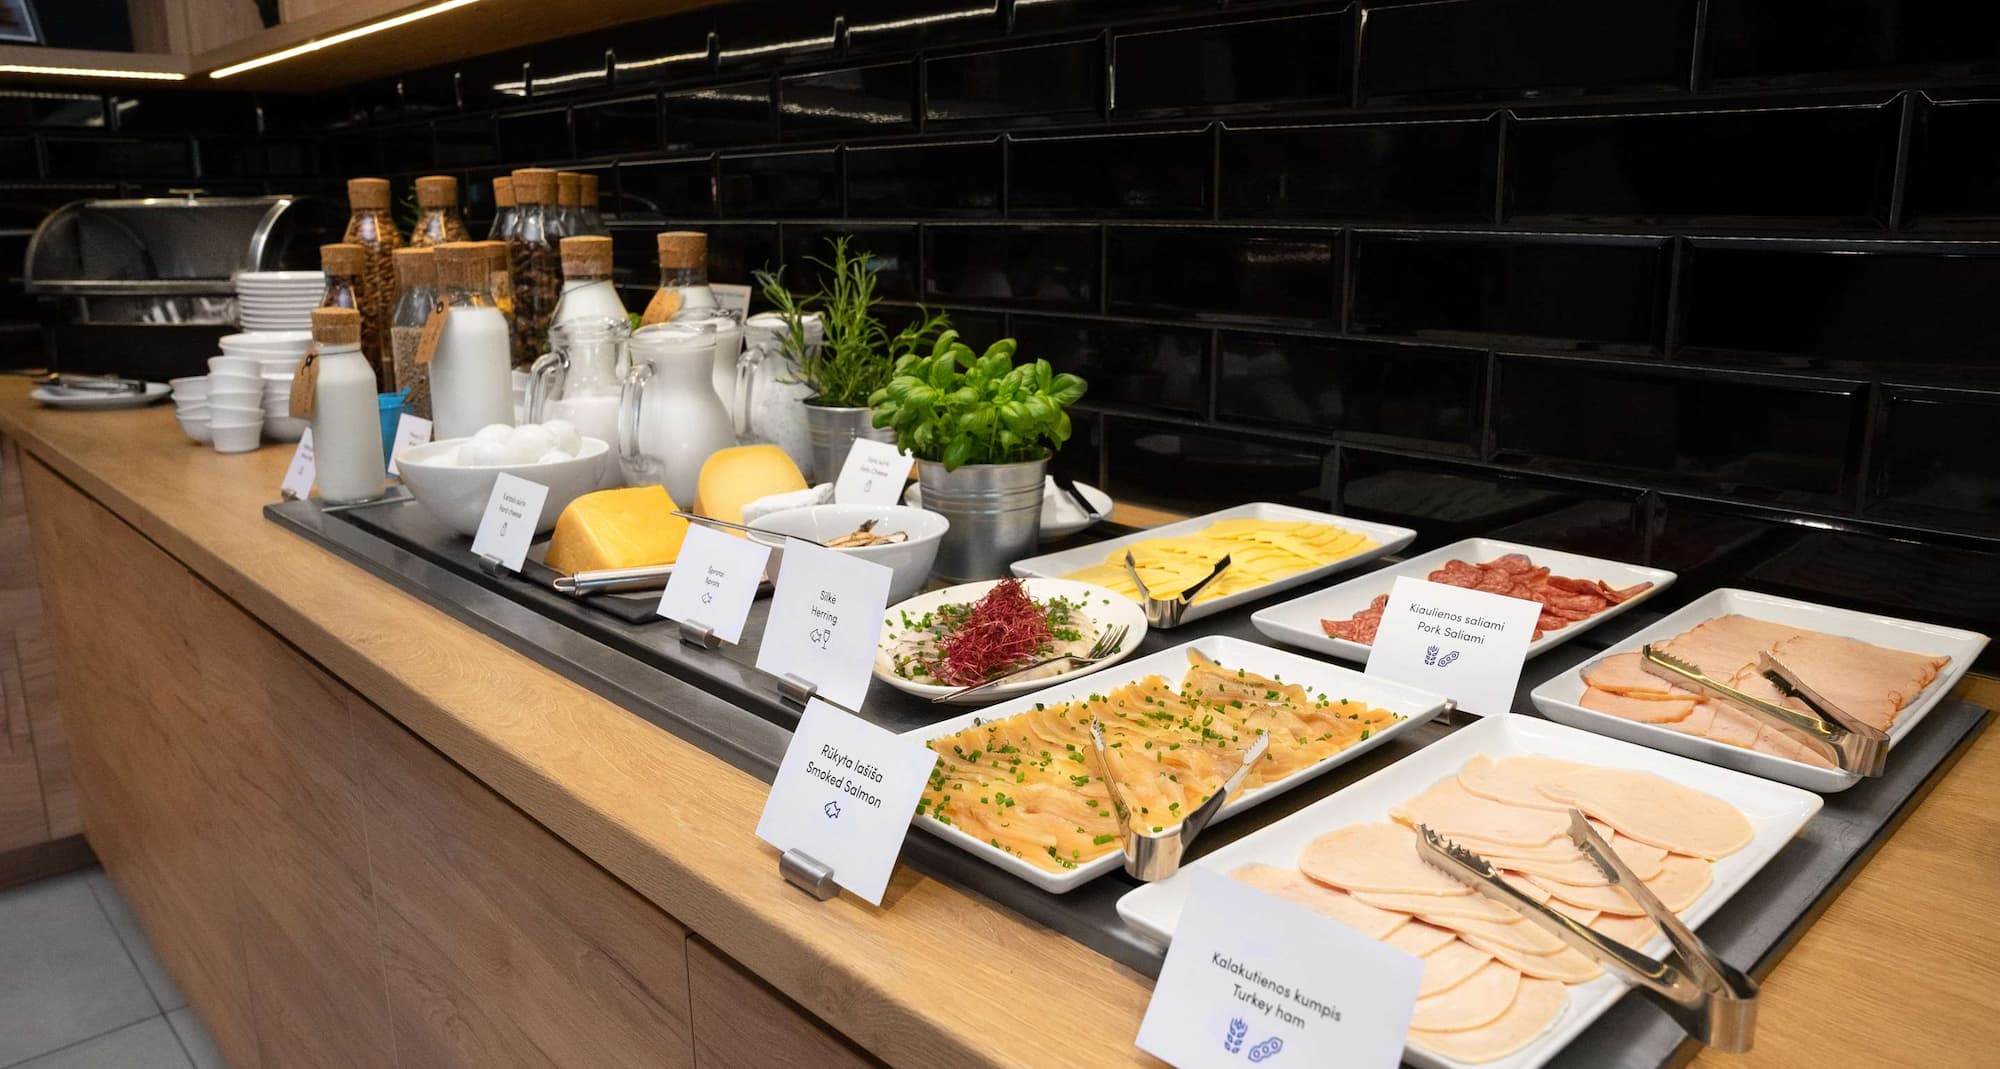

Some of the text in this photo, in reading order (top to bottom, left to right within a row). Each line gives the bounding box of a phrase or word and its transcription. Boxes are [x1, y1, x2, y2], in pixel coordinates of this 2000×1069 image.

[820, 590, 837, 605] Silkė
[811, 605, 838, 626] Herring
[1409, 602, 1506, 632] Kiaulienos saliami
[1417, 621, 1486, 645] Pork Saliami
[821, 744, 884, 784] Rūkyta lašiša
[806, 761, 882, 809] Smoked Salmon
[1211, 951, 1343, 1023] Kalakutienos kumpis
[1232, 984, 1306, 1030] Turkey ham
